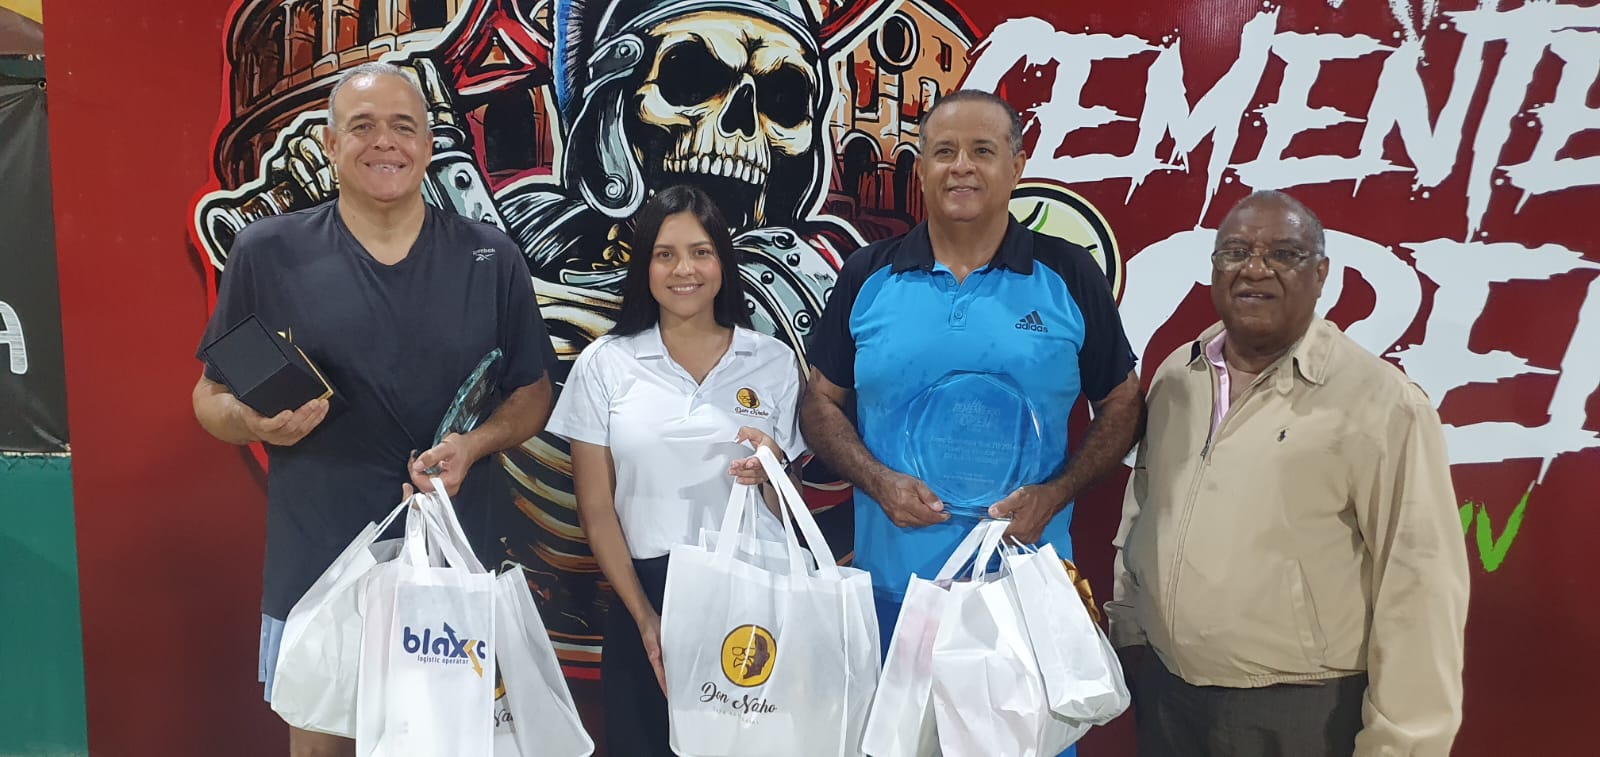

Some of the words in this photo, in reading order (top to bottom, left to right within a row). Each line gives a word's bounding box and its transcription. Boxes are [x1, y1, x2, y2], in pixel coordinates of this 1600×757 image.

[1015, 322, 1049, 334] adidas
[417, 655, 440, 664] logistic
[699, 681, 729, 704] Don
